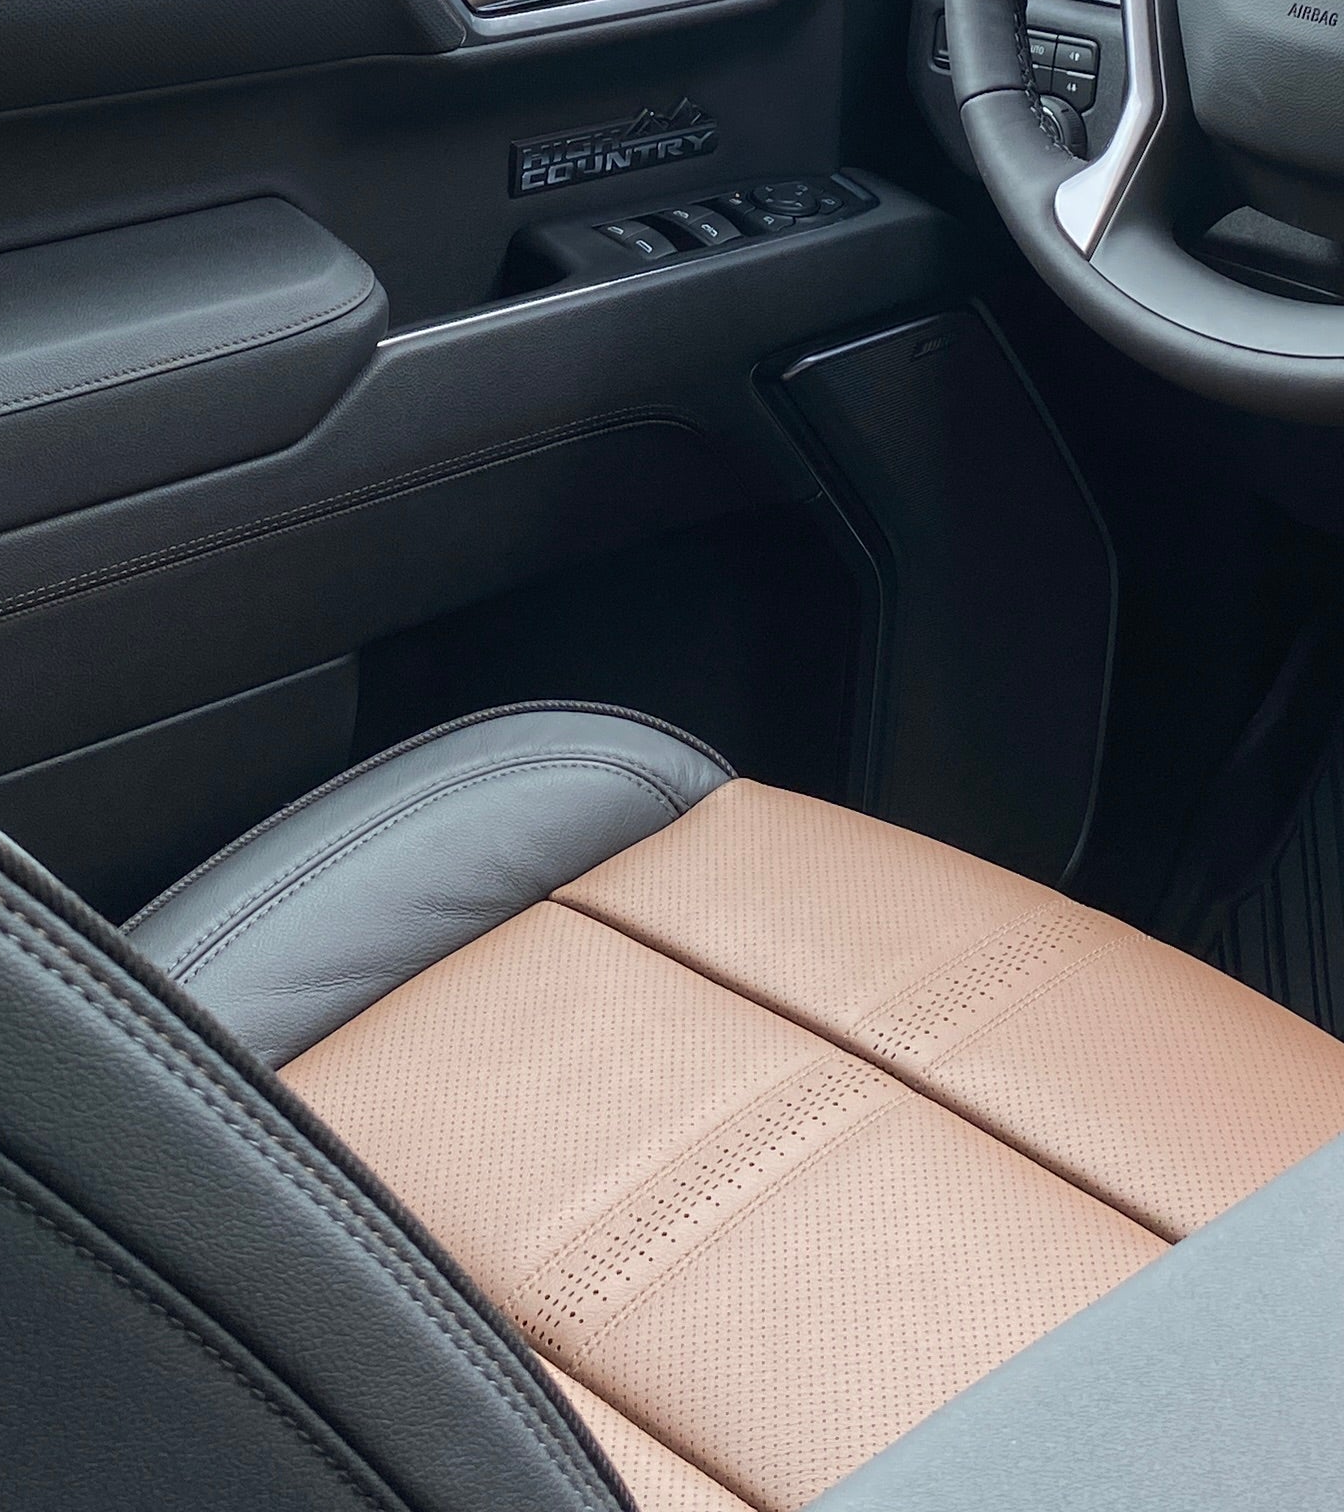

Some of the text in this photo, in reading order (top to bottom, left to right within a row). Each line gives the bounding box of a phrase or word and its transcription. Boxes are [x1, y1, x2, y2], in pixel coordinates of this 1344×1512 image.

[1287, 3, 1339, 26] AIRBAG
[522, 129, 621, 170] HIGH
[522, 130, 715, 191] COUNTRY
